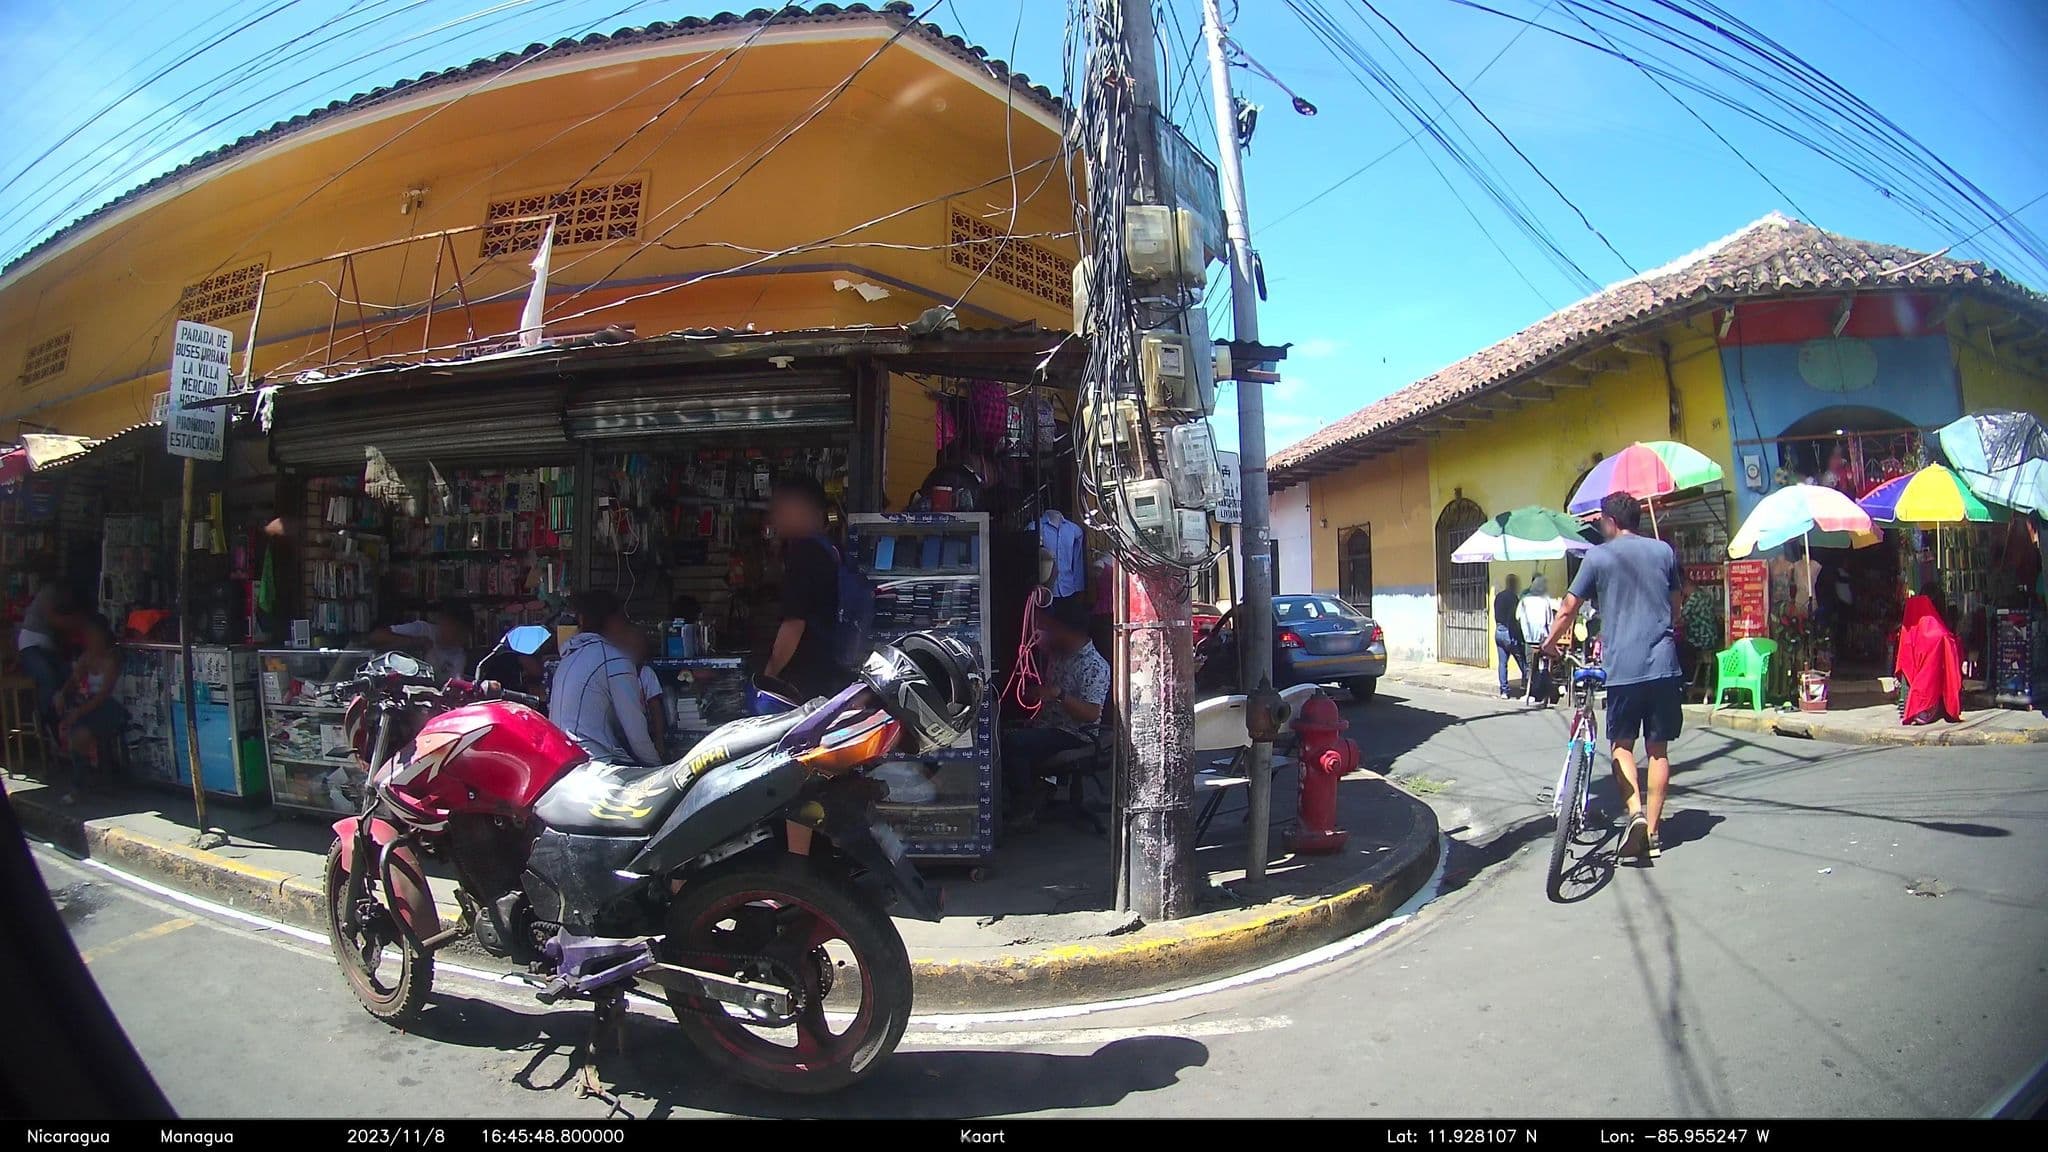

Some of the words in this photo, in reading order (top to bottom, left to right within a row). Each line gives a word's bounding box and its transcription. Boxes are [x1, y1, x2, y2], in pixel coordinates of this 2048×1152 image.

[181, 327, 214, 346] PARADA
[217, 335, 228, 349] DE
[176, 343, 200, 359] BUSES
[183, 361, 193, 375] LA
[199, 363, 219, 380] VILLA
[181, 377, 218, 396] MERCADO
[170, 432, 222, 453] ESTACIONAR
